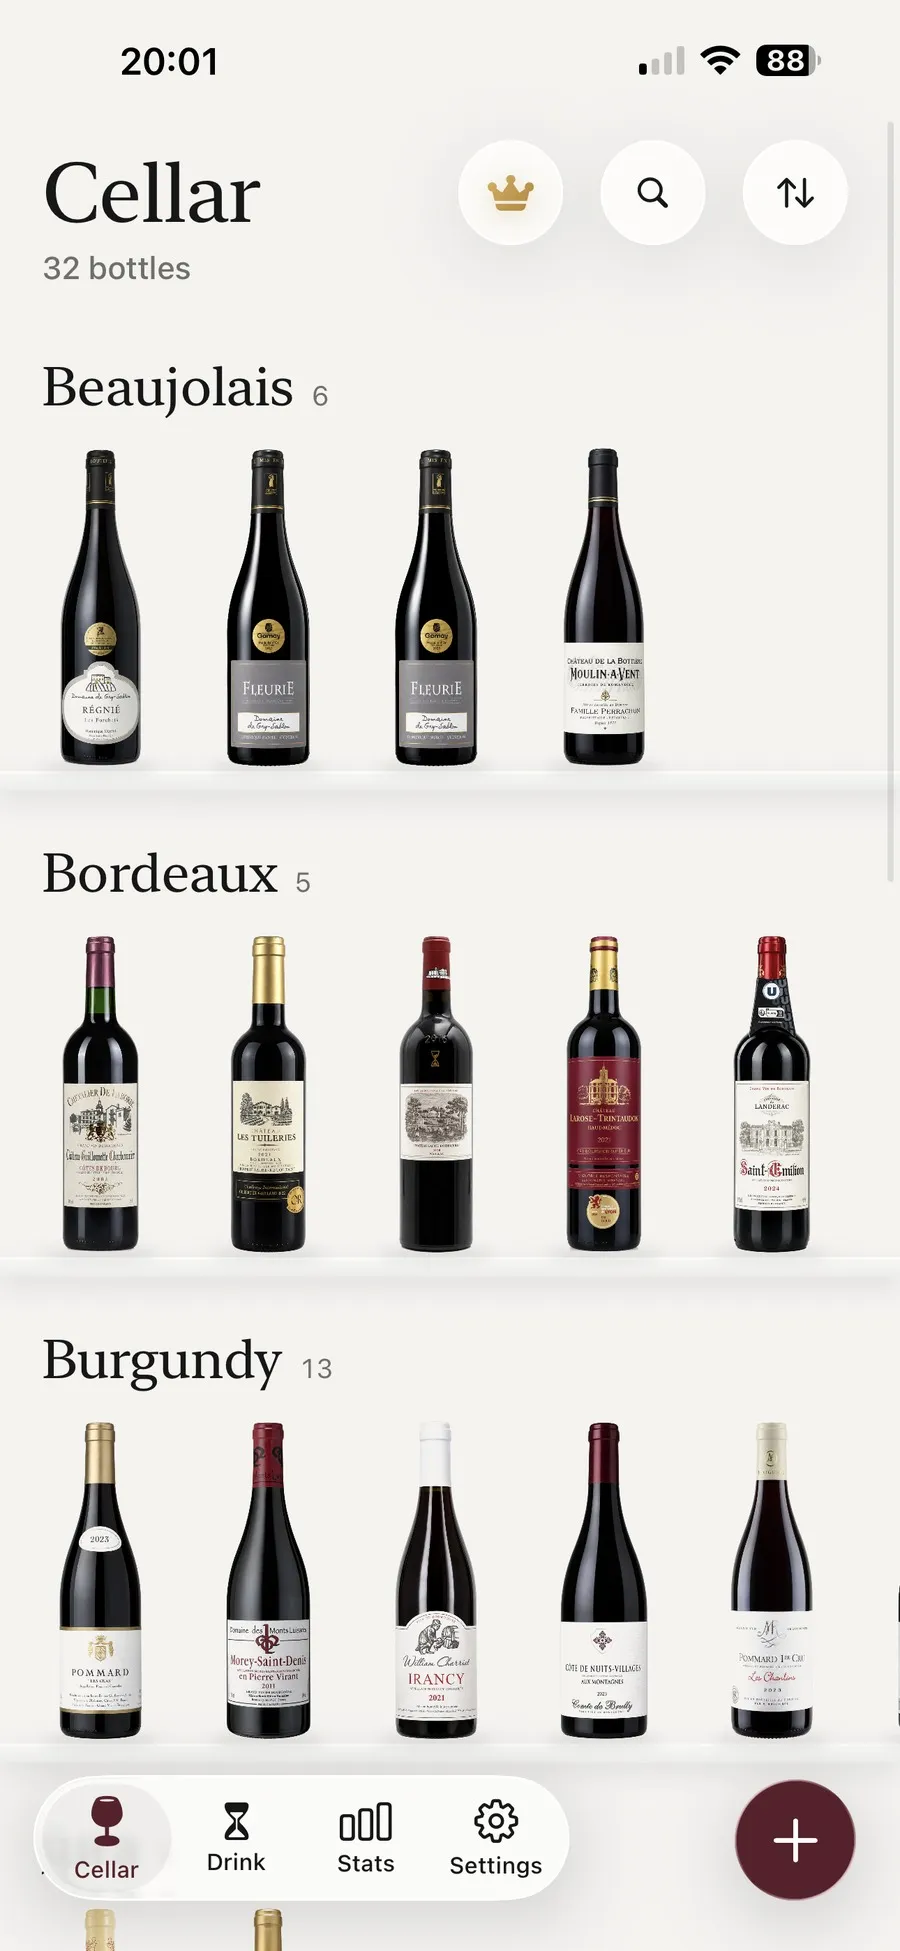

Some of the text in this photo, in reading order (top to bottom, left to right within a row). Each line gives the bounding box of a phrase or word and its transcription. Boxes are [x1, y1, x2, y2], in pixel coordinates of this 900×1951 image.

[121, 47, 217, 77] 20:01
[767, 49, 805, 72] 88
[45, 161, 262, 224] Cellar
[43, 255, 191, 281] 32 bottles
[42, 365, 329, 419] Beaujolais 6
[257, 632, 281, 640] Gamay
[424, 632, 449, 640] Gamay
[242, 680, 295, 696] FLEURIE
[410, 680, 463, 696] FLEURIE
[82, 704, 121, 714] RÉGNIÉ
[42, 851, 312, 894] Bordeaux 5
[237, 1133, 297, 1142] LES TUILERIES
[42, 1338, 333, 1392] Burgundy 13
[89, 1535, 110, 1543] 2023
[230, 1655, 307, 1670] Morey-Saint-Denis
[402, 1655, 436, 1668] William
[579, 1664, 588, 1673] DE
[71, 1669, 130, 1677] POMMARD
[239, 1673, 299, 1681] en Pierre Virant
[408, 1673, 466, 1686] IRANCY
[74, 1859, 140, 1879] Cellar
[207, 1851, 266, 1872] Drink
[337, 1854, 396, 1874] Stats
[450, 1855, 543, 1879] Settings
